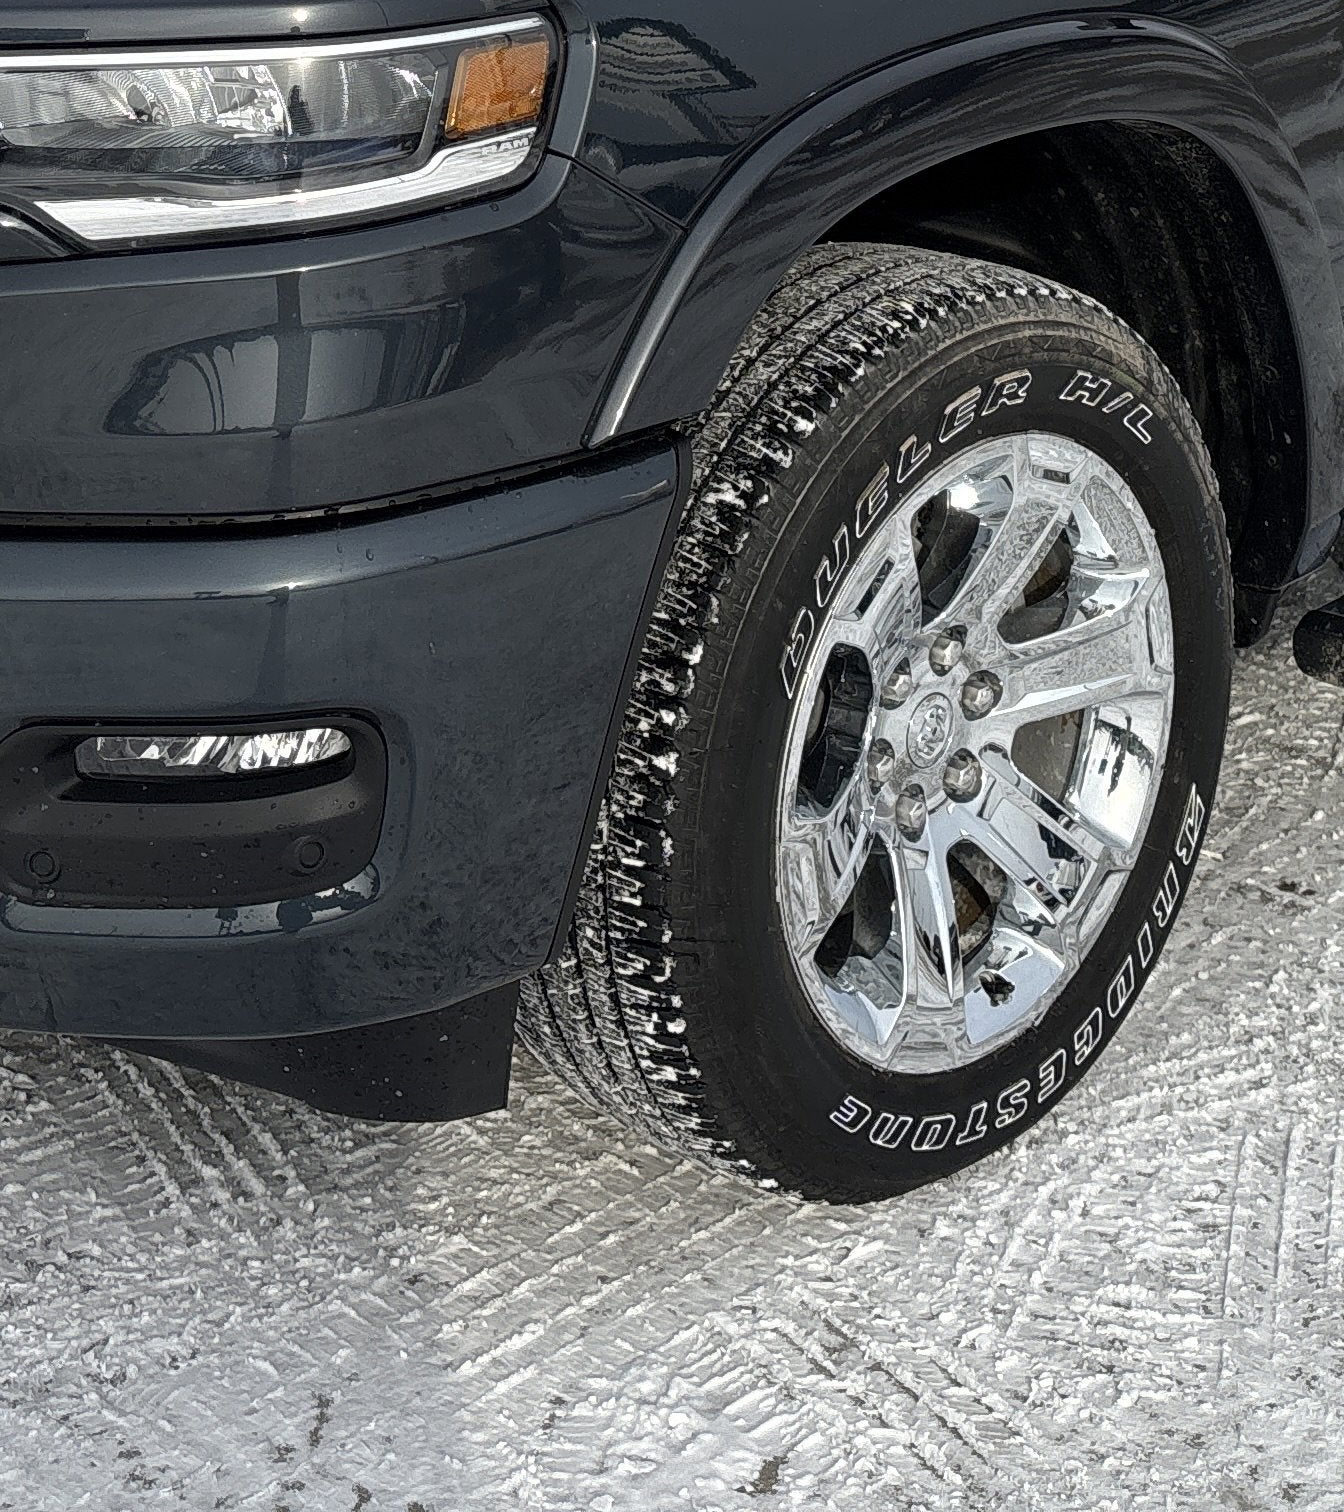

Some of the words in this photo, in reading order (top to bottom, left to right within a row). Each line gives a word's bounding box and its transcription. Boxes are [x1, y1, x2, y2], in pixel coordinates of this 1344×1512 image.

[481, 136, 529, 156] RAM
[779, 369, 1032, 700] DUELER
[1059, 369, 1154, 445] H/L
[830, 782, 1206, 1151] BRIDGESTONE
